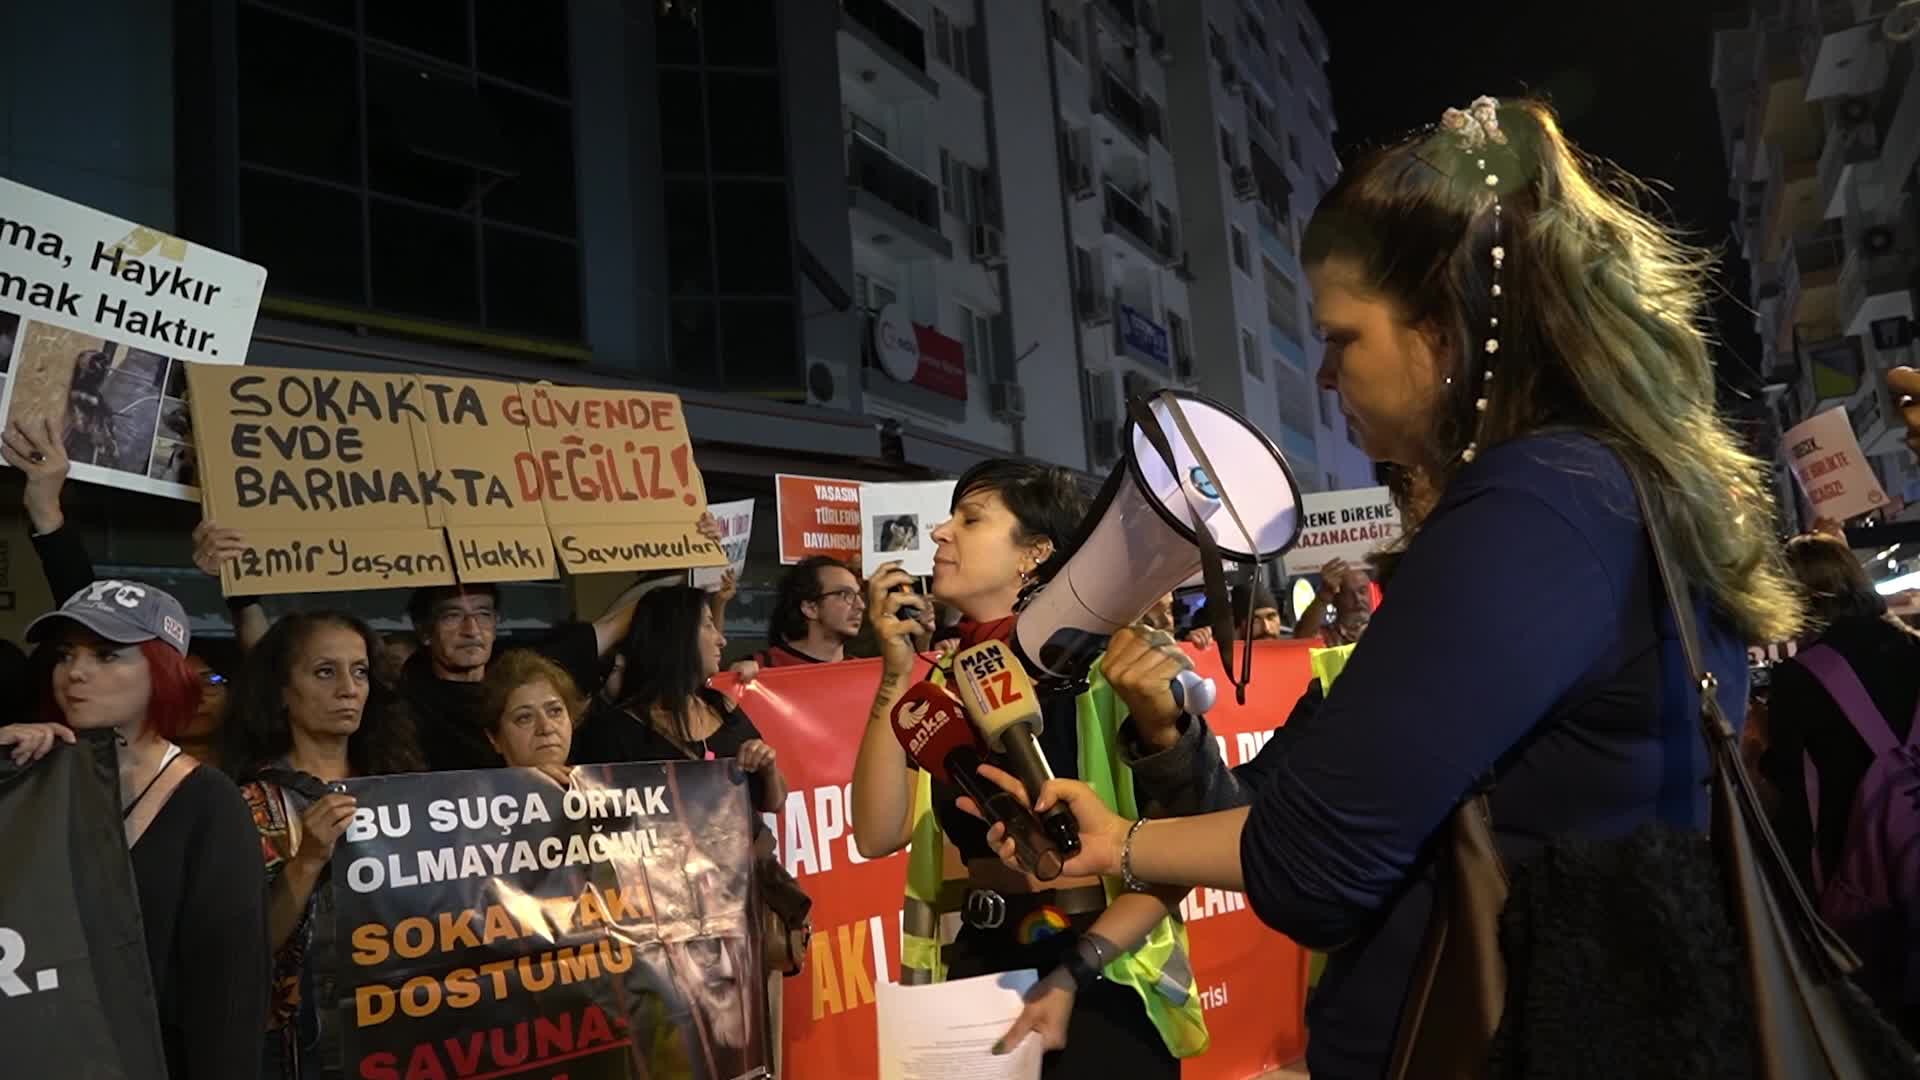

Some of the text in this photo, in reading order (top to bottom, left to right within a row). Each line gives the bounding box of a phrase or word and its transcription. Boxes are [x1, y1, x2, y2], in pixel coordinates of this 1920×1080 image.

[91, 241, 221, 305] Haykır
[95, 293, 219, 356] Haktır.
[231, 376, 488, 425] SOKAKTA
[502, 388, 674, 431] GÜVENDE
[231, 424, 363, 462] EVDE
[235, 466, 514, 512] BARINAKTA
[1295, 523, 1393, 549] AZANACAĞIZ
[327, 539, 445, 580] Yaşam
[459, 540, 545, 571] Hakkı
[960, 645, 1001, 672] MAN
[909, 710, 950, 752] anka
[346, 786, 671, 842] BU SUÇA ORTAK
[355, 937, 634, 1027] DOSTUMU
